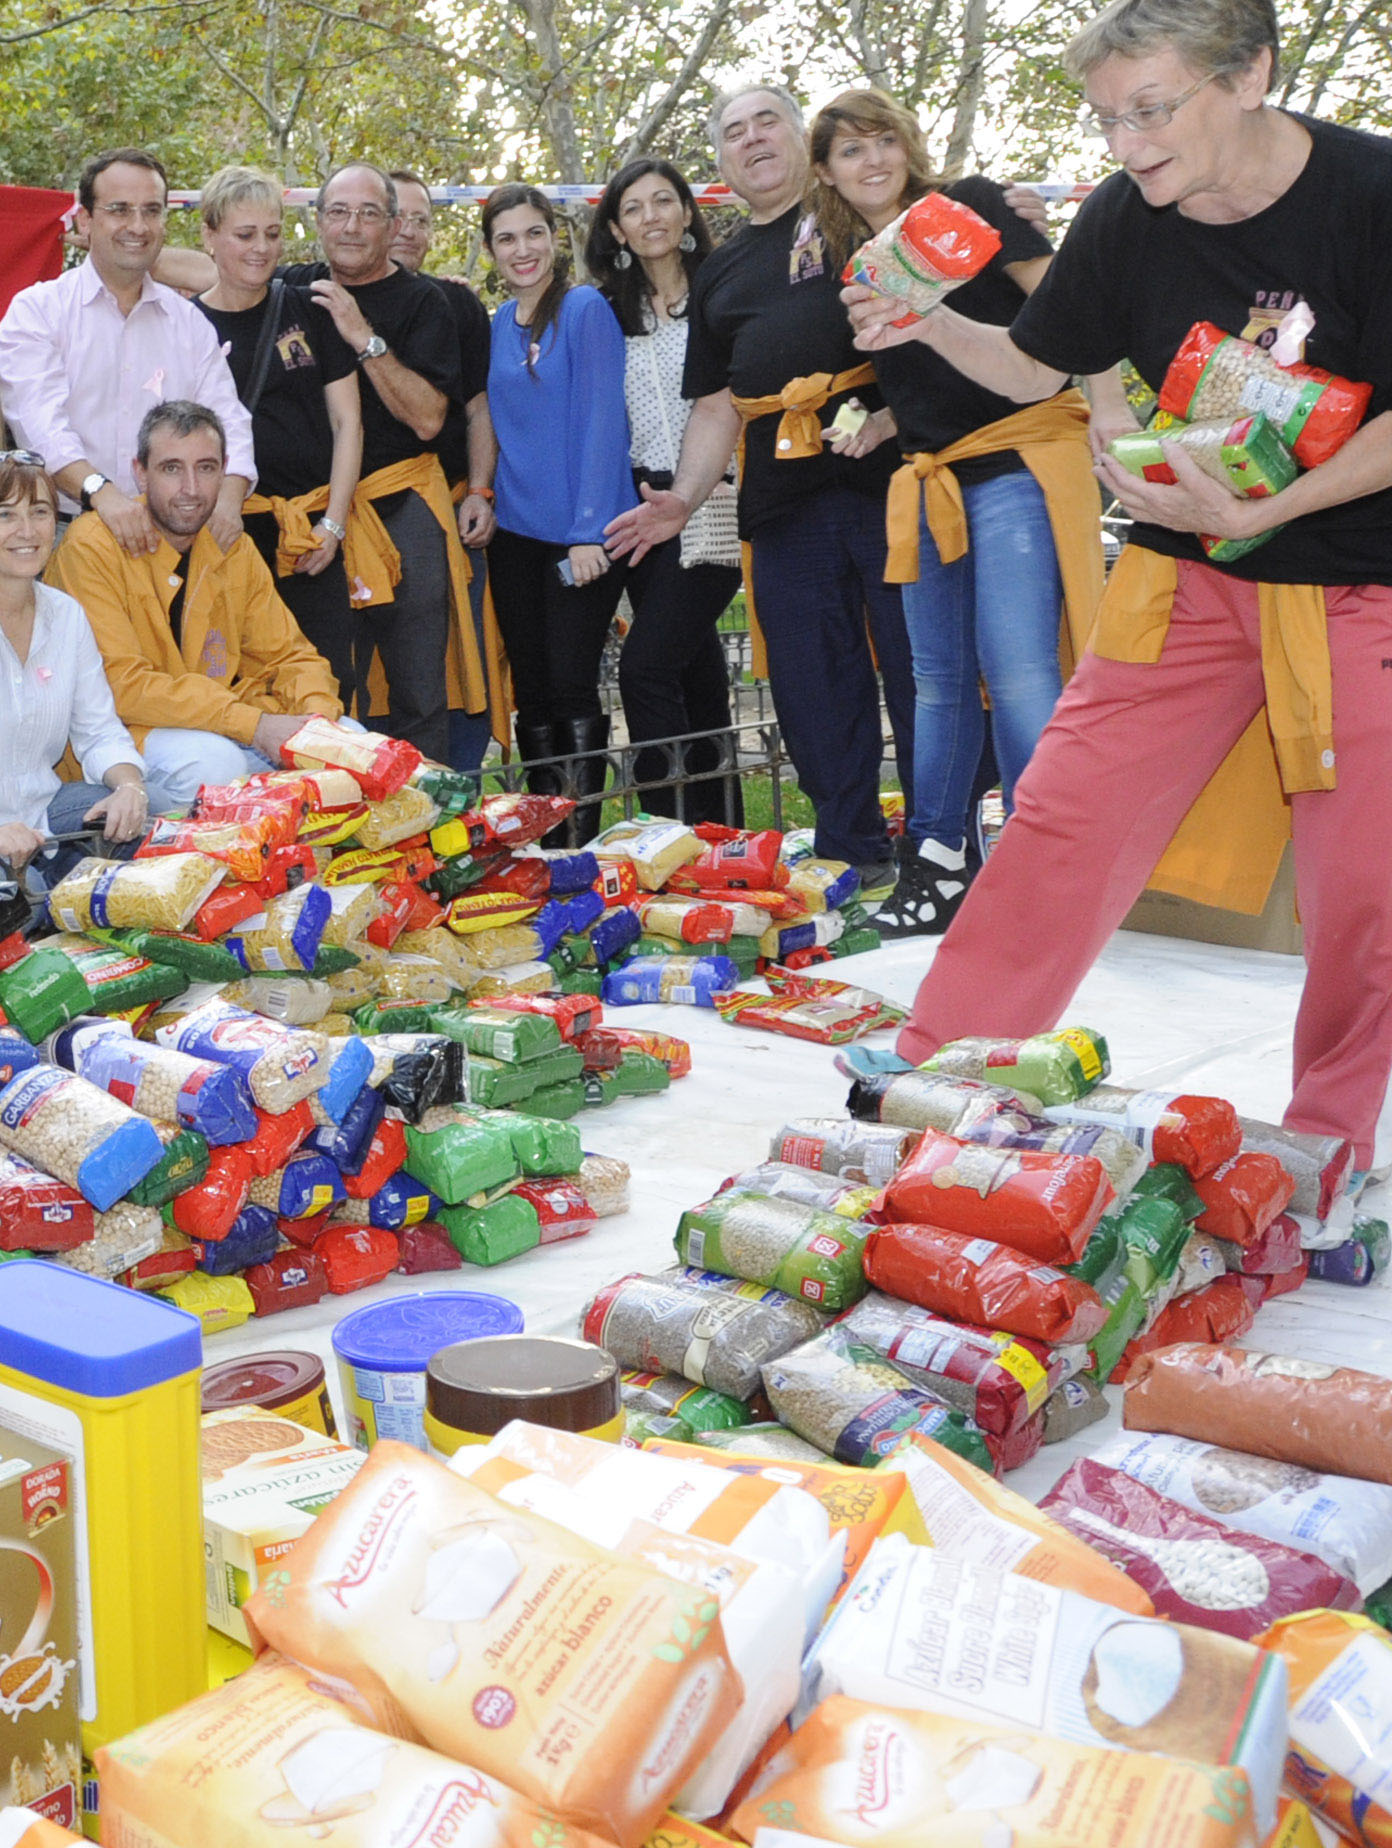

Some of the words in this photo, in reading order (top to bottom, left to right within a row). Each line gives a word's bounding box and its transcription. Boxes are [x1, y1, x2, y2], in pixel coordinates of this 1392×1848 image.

[25, 1468, 62, 1490] DORADA
[202, 1470, 322, 1506] azúcares
[26, 1485, 62, 1509] HORNO
[264, 1541, 296, 1561] aría
[321, 1473, 414, 1610] Azucarera
[562, 1594, 613, 1652] blanco
